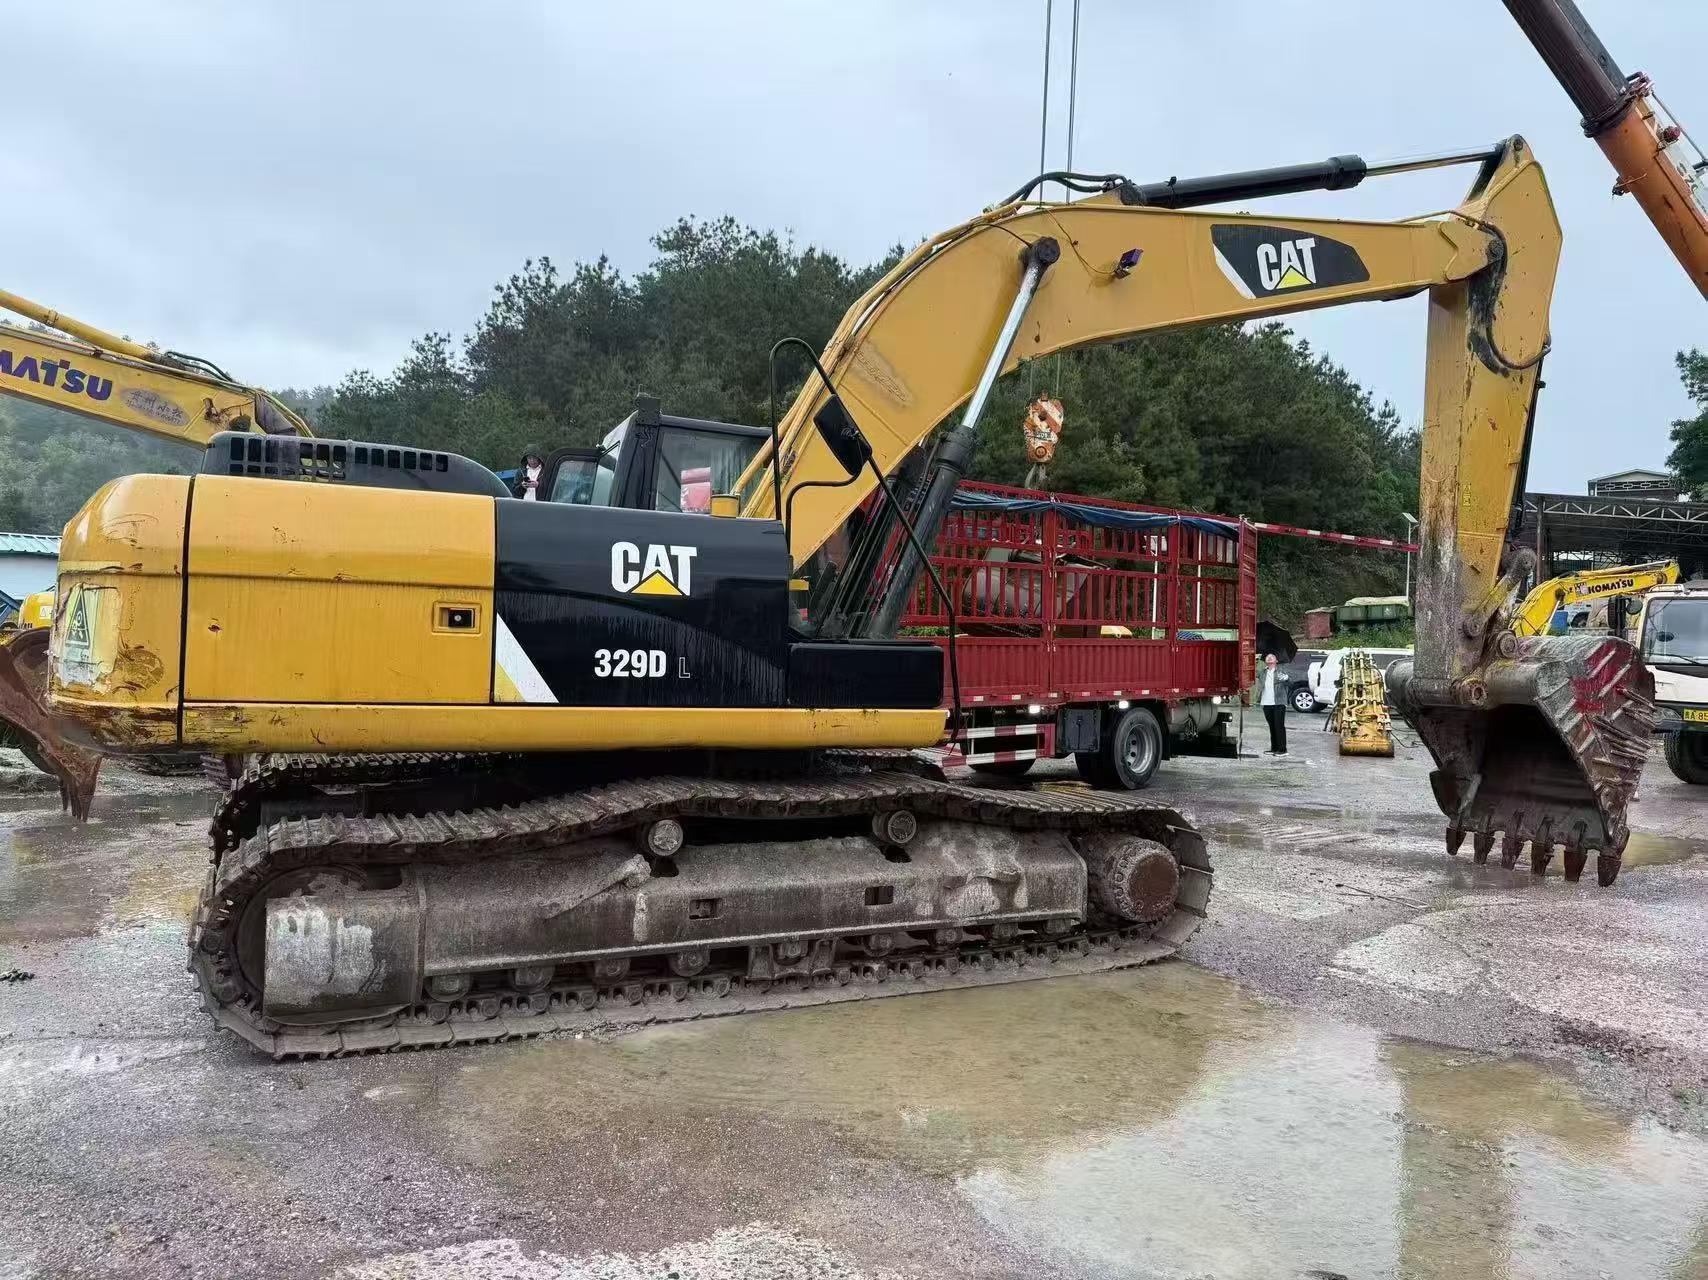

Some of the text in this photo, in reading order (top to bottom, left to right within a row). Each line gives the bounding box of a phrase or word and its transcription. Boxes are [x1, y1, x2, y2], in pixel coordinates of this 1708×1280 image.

[1256, 237, 1316, 290] CAT
[611, 541, 698, 596] CAT
[1588, 579, 1634, 594] KOMATSU
[594, 648, 691, 679] 329D L
